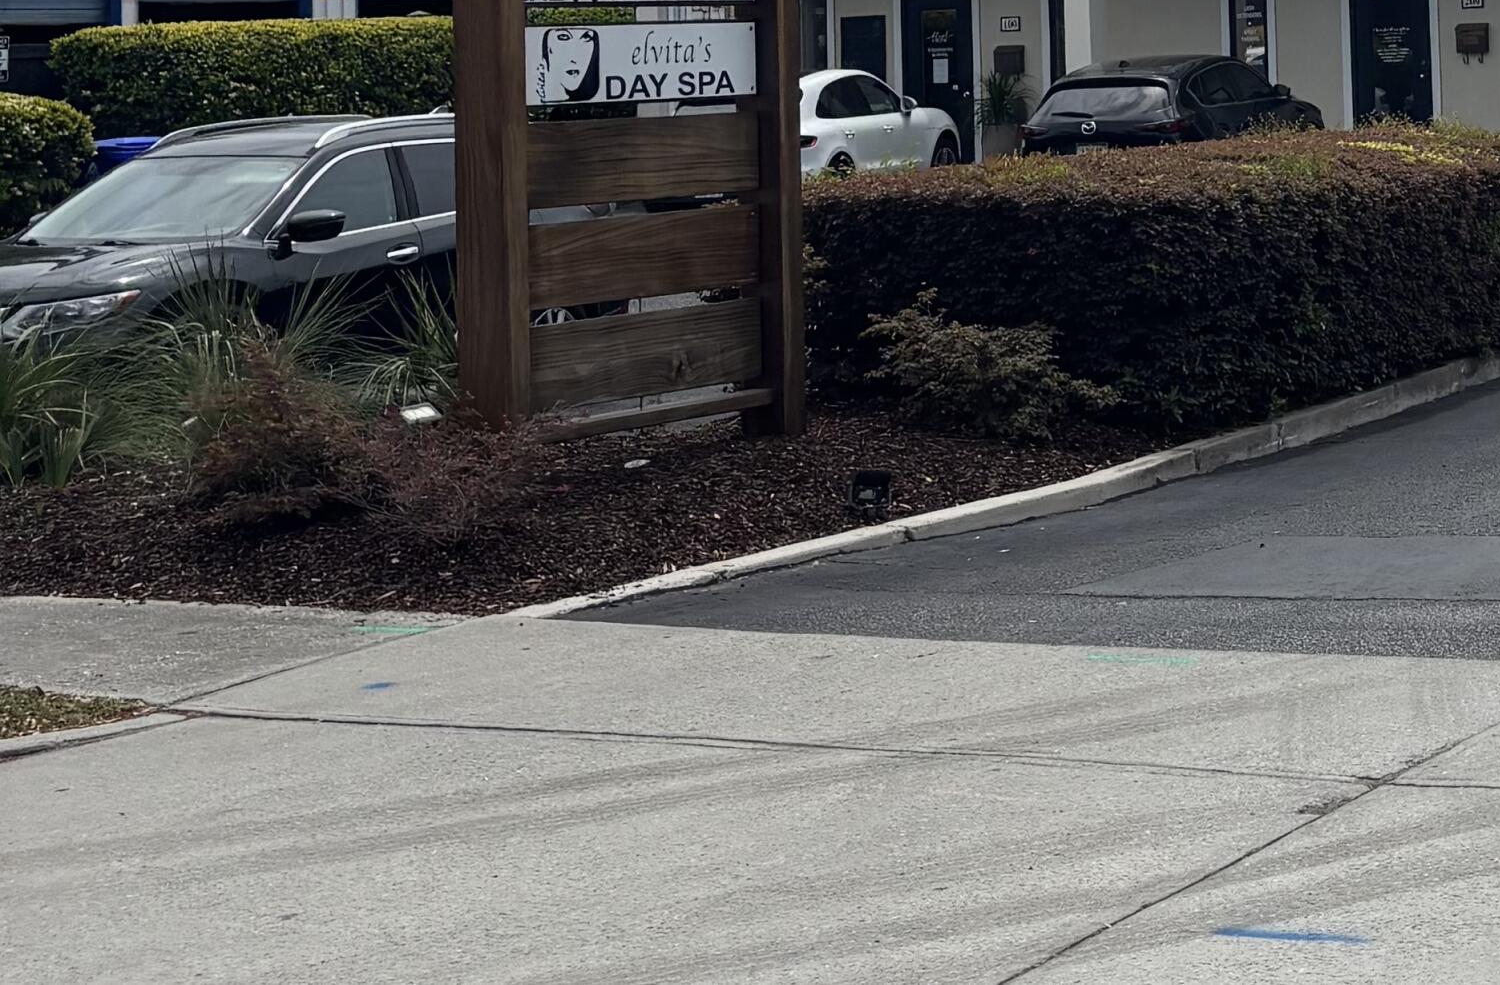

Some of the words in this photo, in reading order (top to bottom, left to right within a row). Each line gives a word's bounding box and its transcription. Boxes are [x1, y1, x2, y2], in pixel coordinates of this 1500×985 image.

[631, 31, 712, 65] elvita's
[605, 73, 668, 100] DAY
[678, 70, 736, 96] SPA
